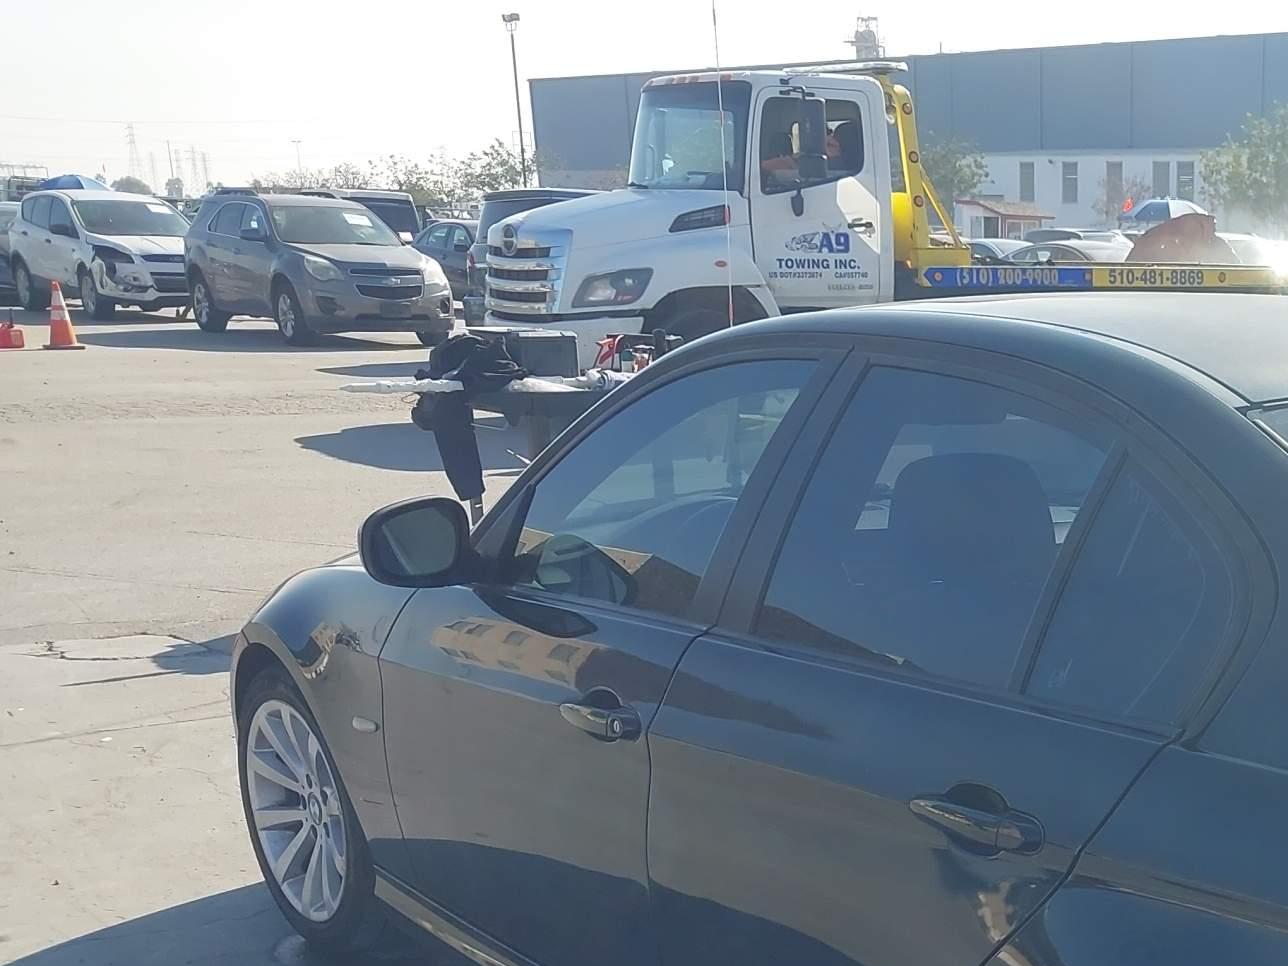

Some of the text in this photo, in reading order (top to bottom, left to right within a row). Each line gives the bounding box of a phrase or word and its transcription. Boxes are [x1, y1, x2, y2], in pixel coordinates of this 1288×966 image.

[819, 232, 850, 253] A9
[776, 259, 861, 269] TOWING INC.
[956, 268, 993, 287] (510)
